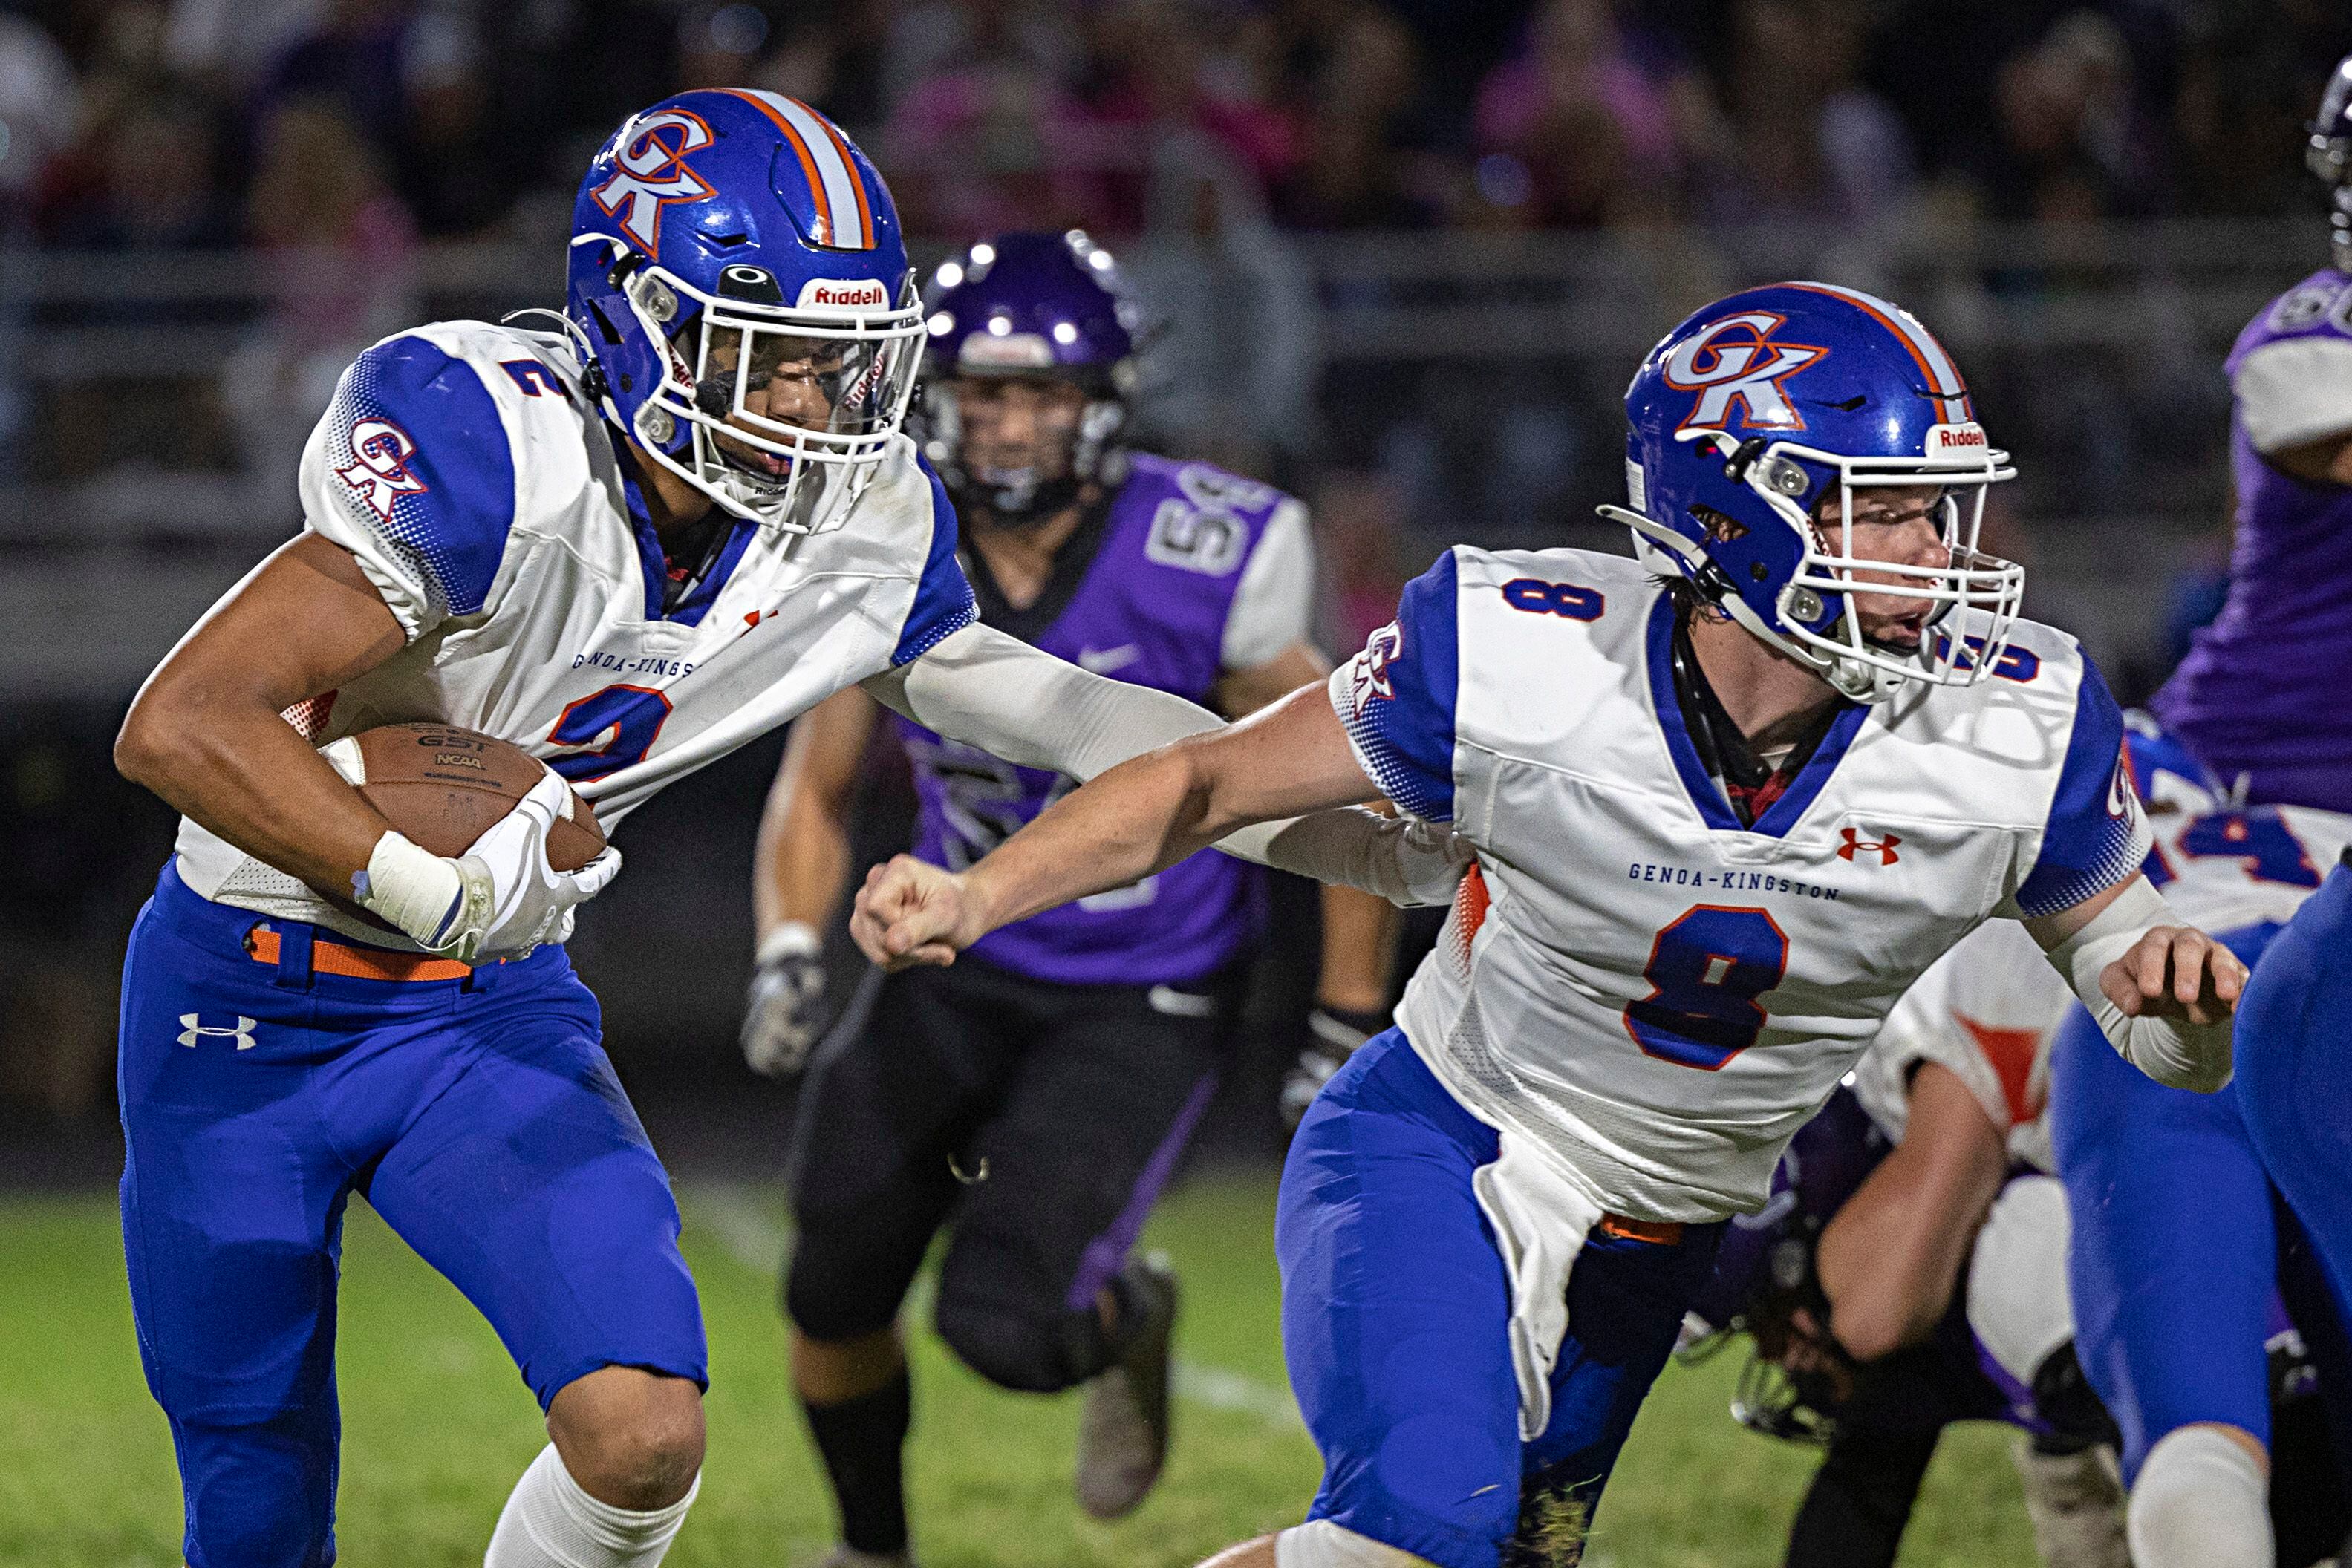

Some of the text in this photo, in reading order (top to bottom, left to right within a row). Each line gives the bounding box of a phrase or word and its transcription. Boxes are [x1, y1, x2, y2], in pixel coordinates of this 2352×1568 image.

[815, 287, 882, 305] Riddell
[1502, 578, 1605, 622] 8
[436, 754, 482, 768] NCAA
[1629, 863, 1840, 901] GENOA-KINGSTON
[1623, 904, 1790, 1071] 8
